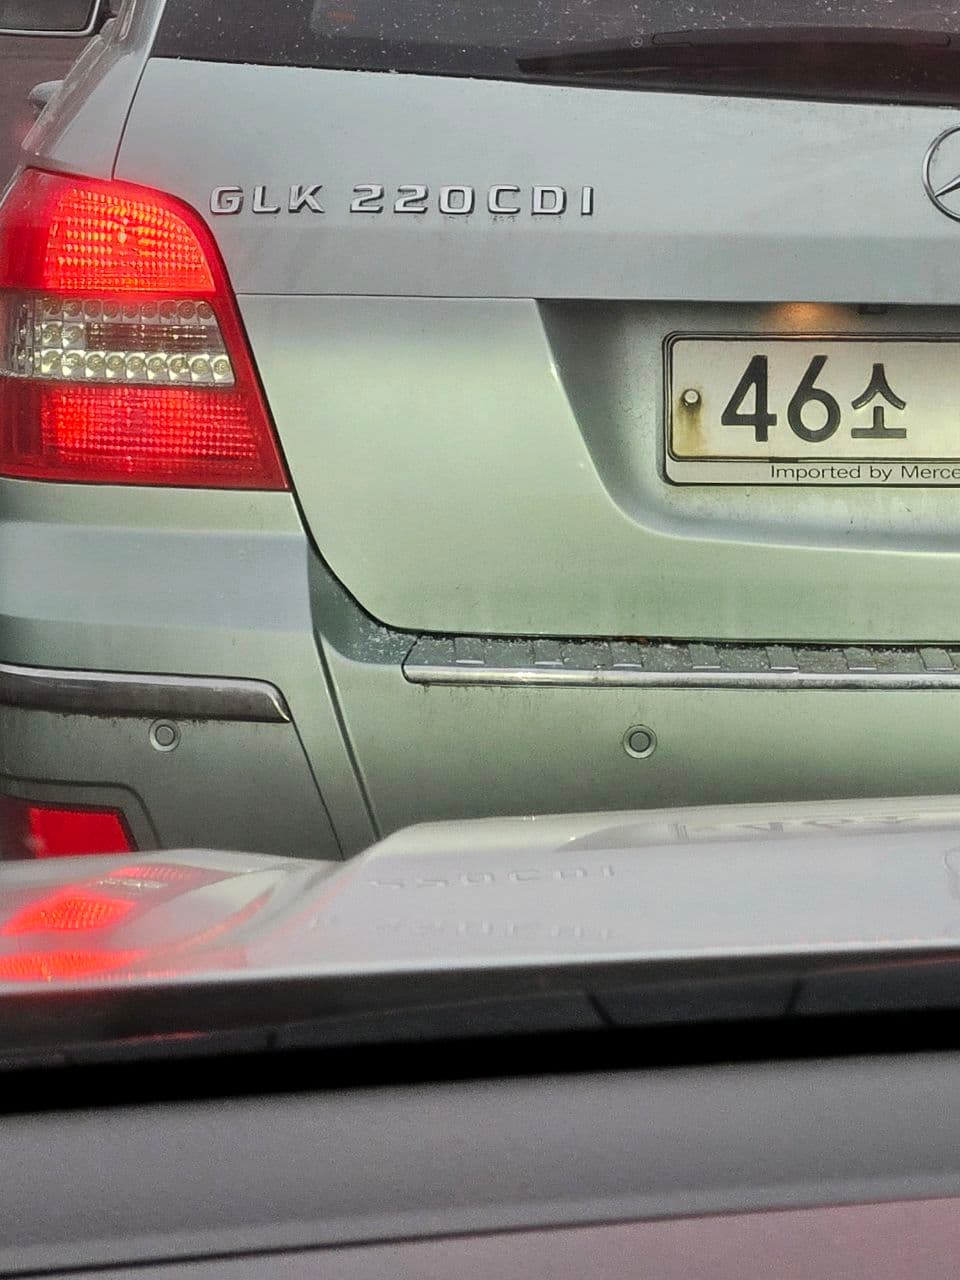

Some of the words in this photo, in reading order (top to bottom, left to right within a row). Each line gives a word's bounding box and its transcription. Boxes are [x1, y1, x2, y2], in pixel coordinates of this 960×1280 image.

[209, 184, 326, 215] GLK
[720, 353, 907, 443] 46소
[770, 464, 861, 482] Imported
[869, 464, 893, 482] by
